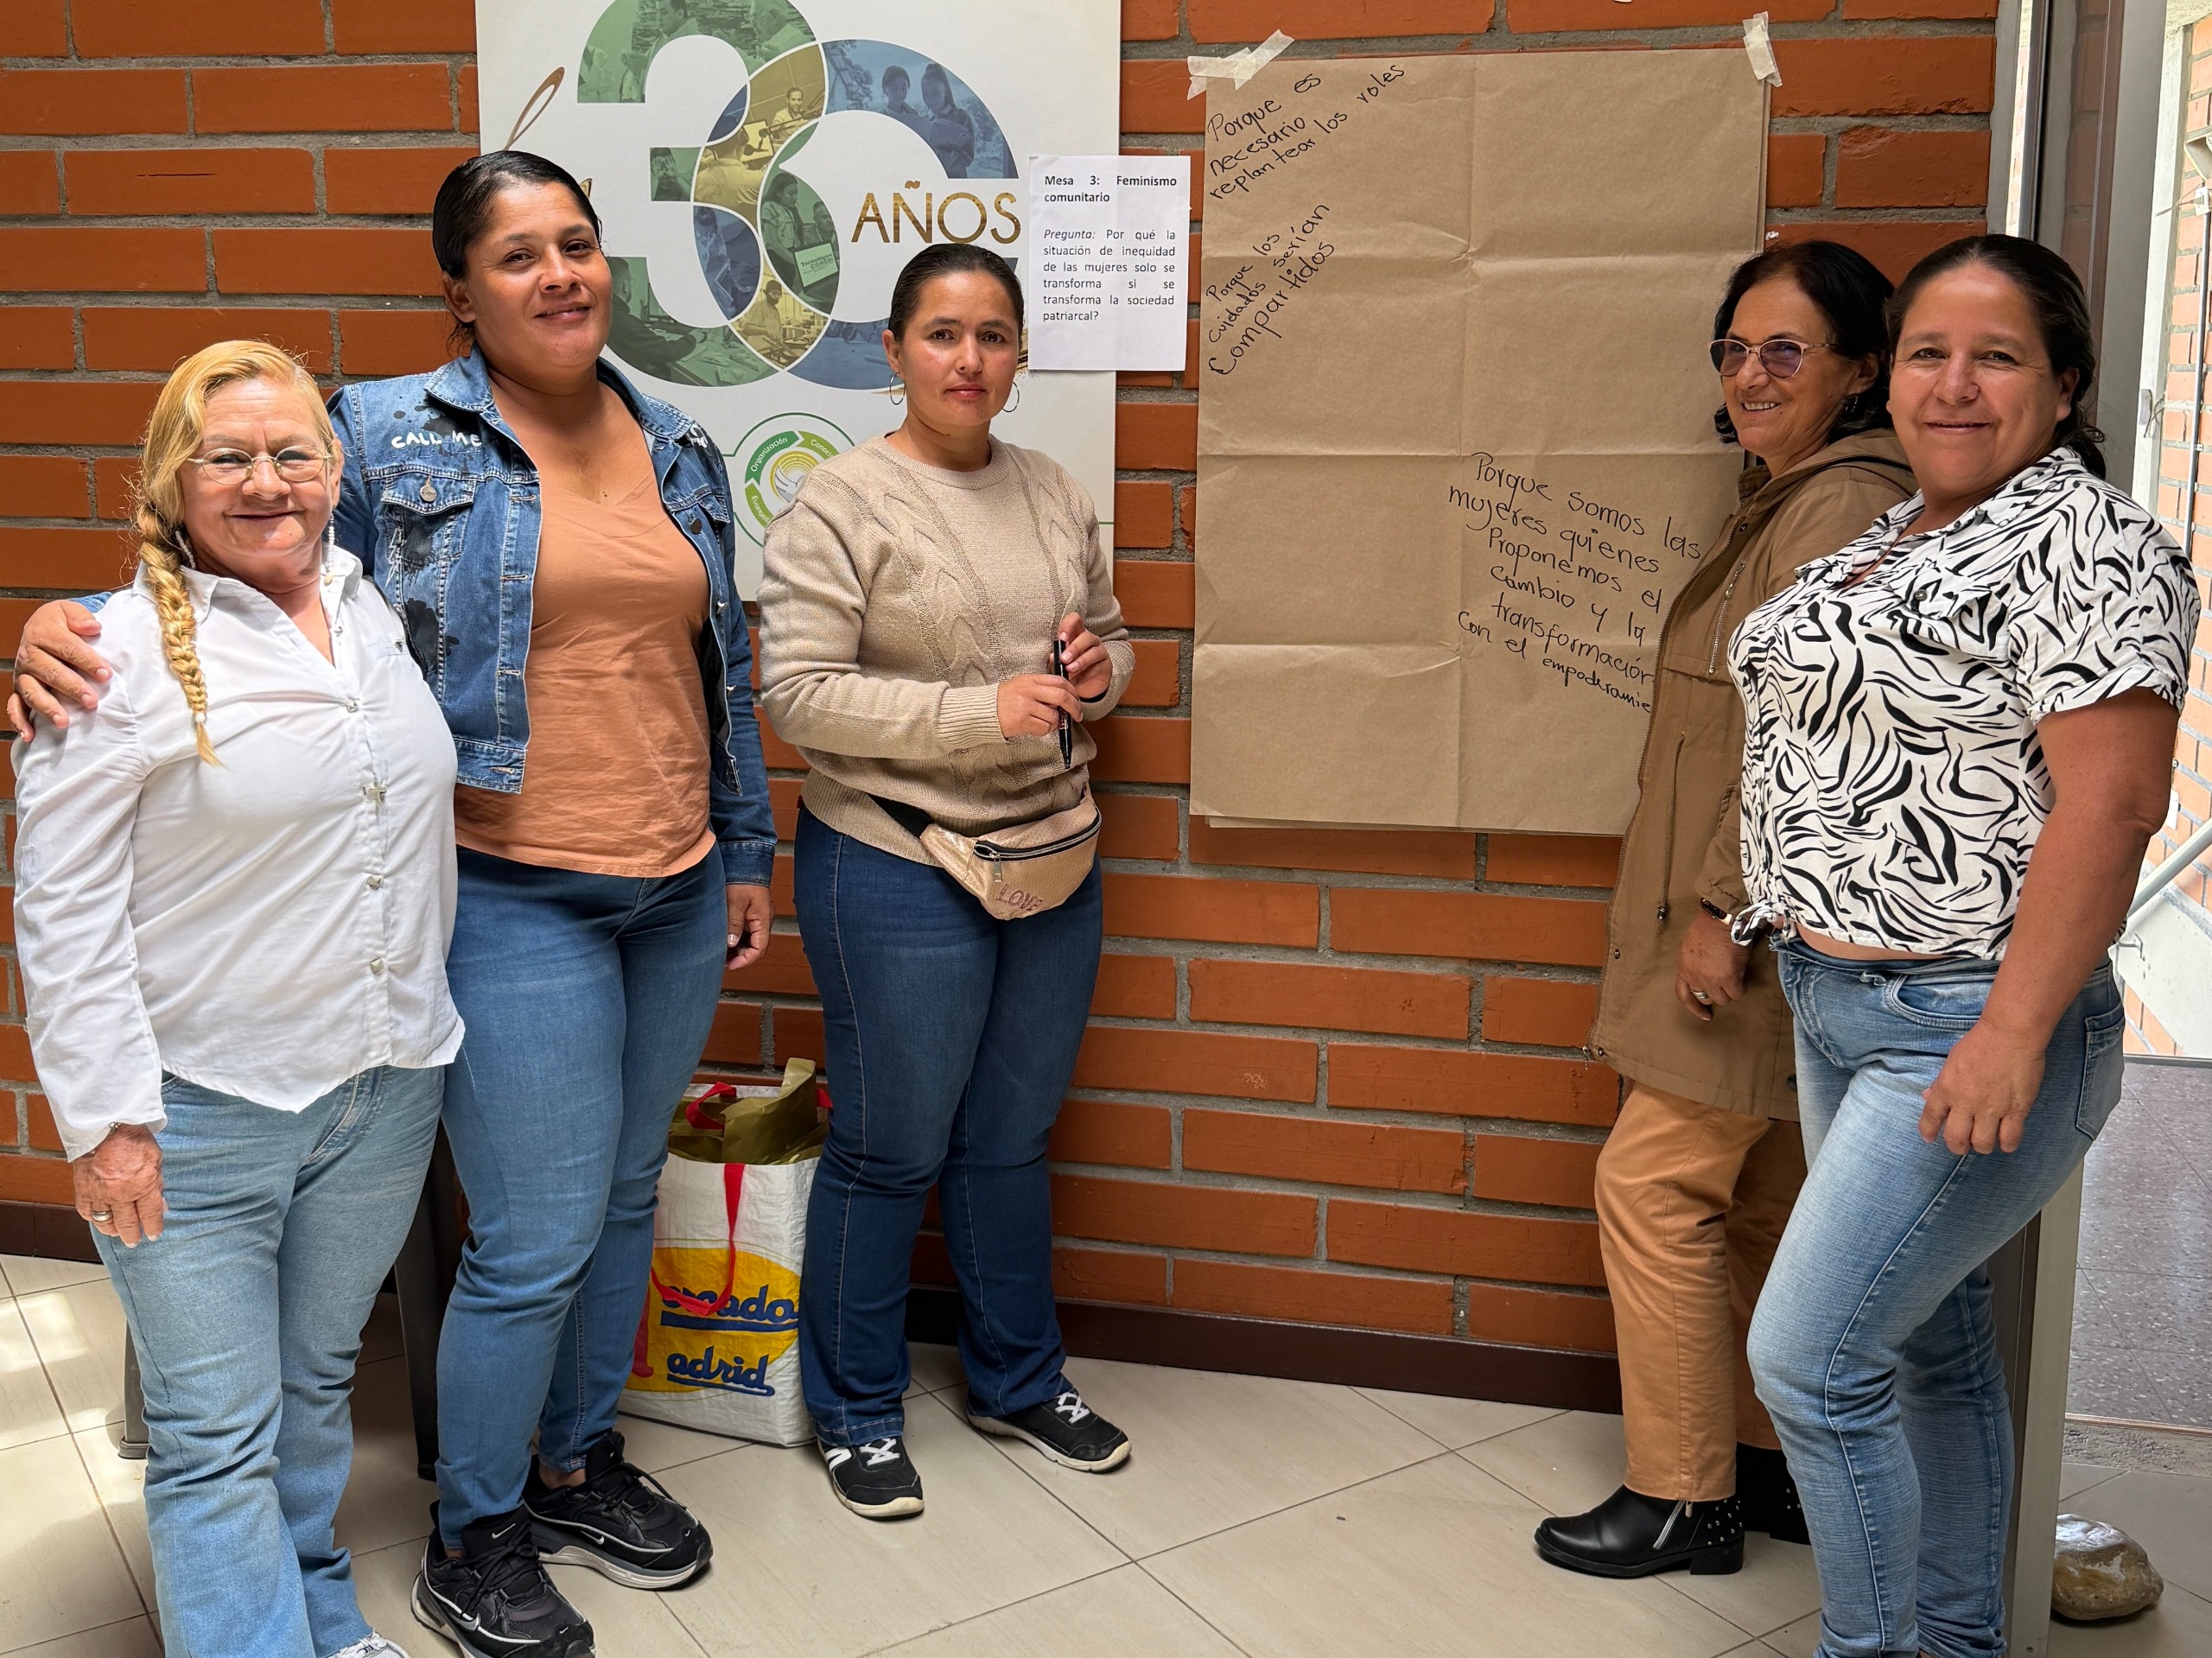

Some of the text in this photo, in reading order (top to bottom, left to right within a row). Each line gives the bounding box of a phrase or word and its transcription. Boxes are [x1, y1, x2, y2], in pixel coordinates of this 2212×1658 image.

[1207, 73, 1321, 142] Porque es
[1313, 112, 1347, 134] los
[1357, 65, 1404, 104] roles
[1210, 117, 1306, 177] necesario
[1044, 175, 1177, 187] Mesa 3: Feminismo
[1044, 192, 1110, 202] comunitario
[851, 180, 1021, 245] AÑOS
[1044, 229, 1175, 242] Pregunta: Por qué la
[1274, 205, 1331, 268] serían
[1044, 245, 1175, 258] situación de inequidad
[1043, 262, 1175, 276] de las mujeres solo se
[1206, 234, 1280, 302] Porque los
[1043, 278, 1175, 289] transforma si se
[1043, 295, 1174, 305] transforma la sociedad
[1043, 311, 1099, 322] patriarcal?
[391, 430, 482, 448] CALL ME
[750, 437, 788, 472] Organización
[1471, 452, 1553, 512] Porque
[1665, 517, 1700, 559] las
[1449, 486, 1658, 573] mujeres quienes
[1642, 588, 1662, 613] el
[1629, 612, 1645, 647] la
[1504, 638, 1526, 659] el
[995, 883, 1043, 912] LOVE
